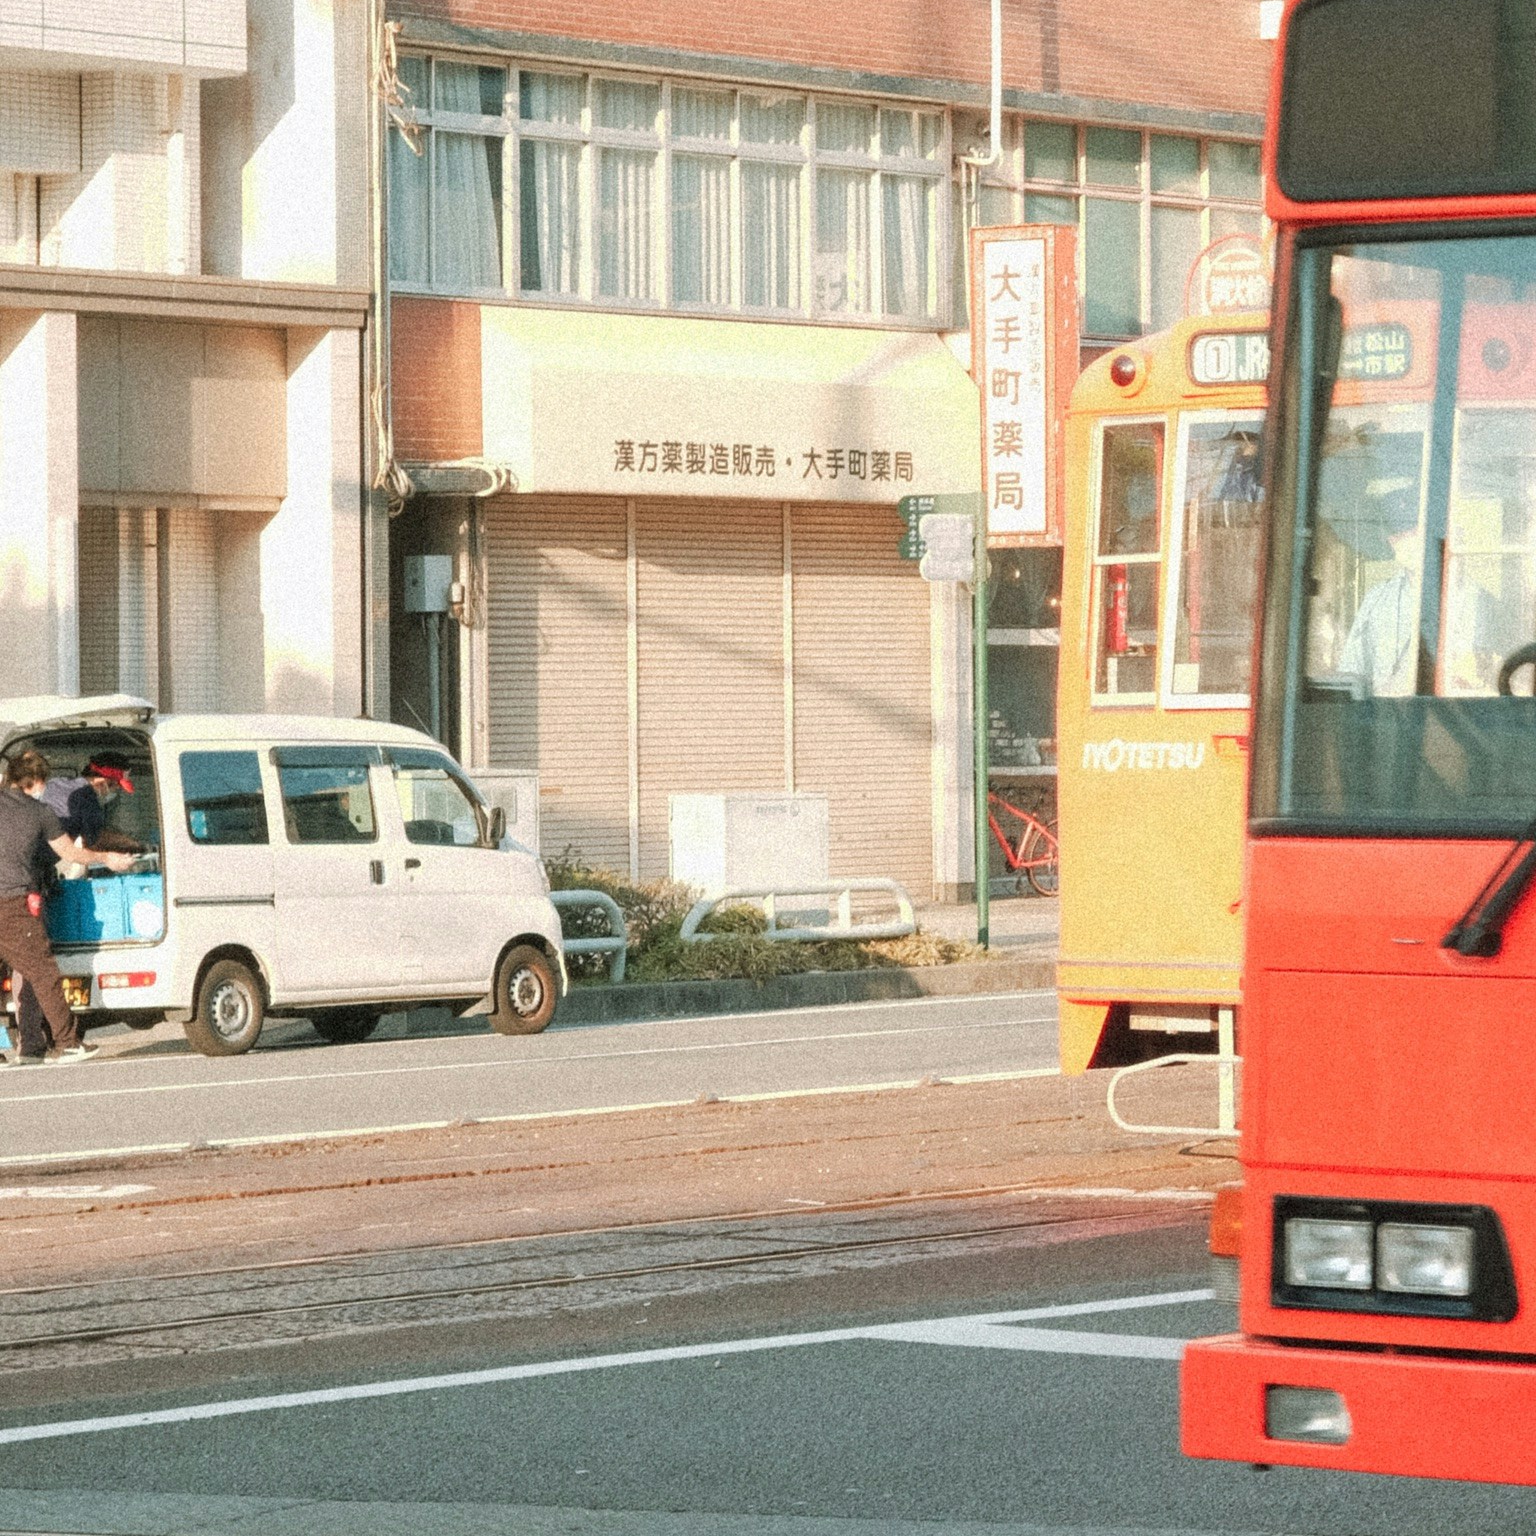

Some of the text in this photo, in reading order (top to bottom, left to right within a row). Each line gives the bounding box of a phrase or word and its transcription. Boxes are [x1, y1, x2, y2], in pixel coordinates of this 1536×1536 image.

[990, 264, 1024, 511] 大手町薬局
[1081, 738, 1205, 772] IYOTETSU
